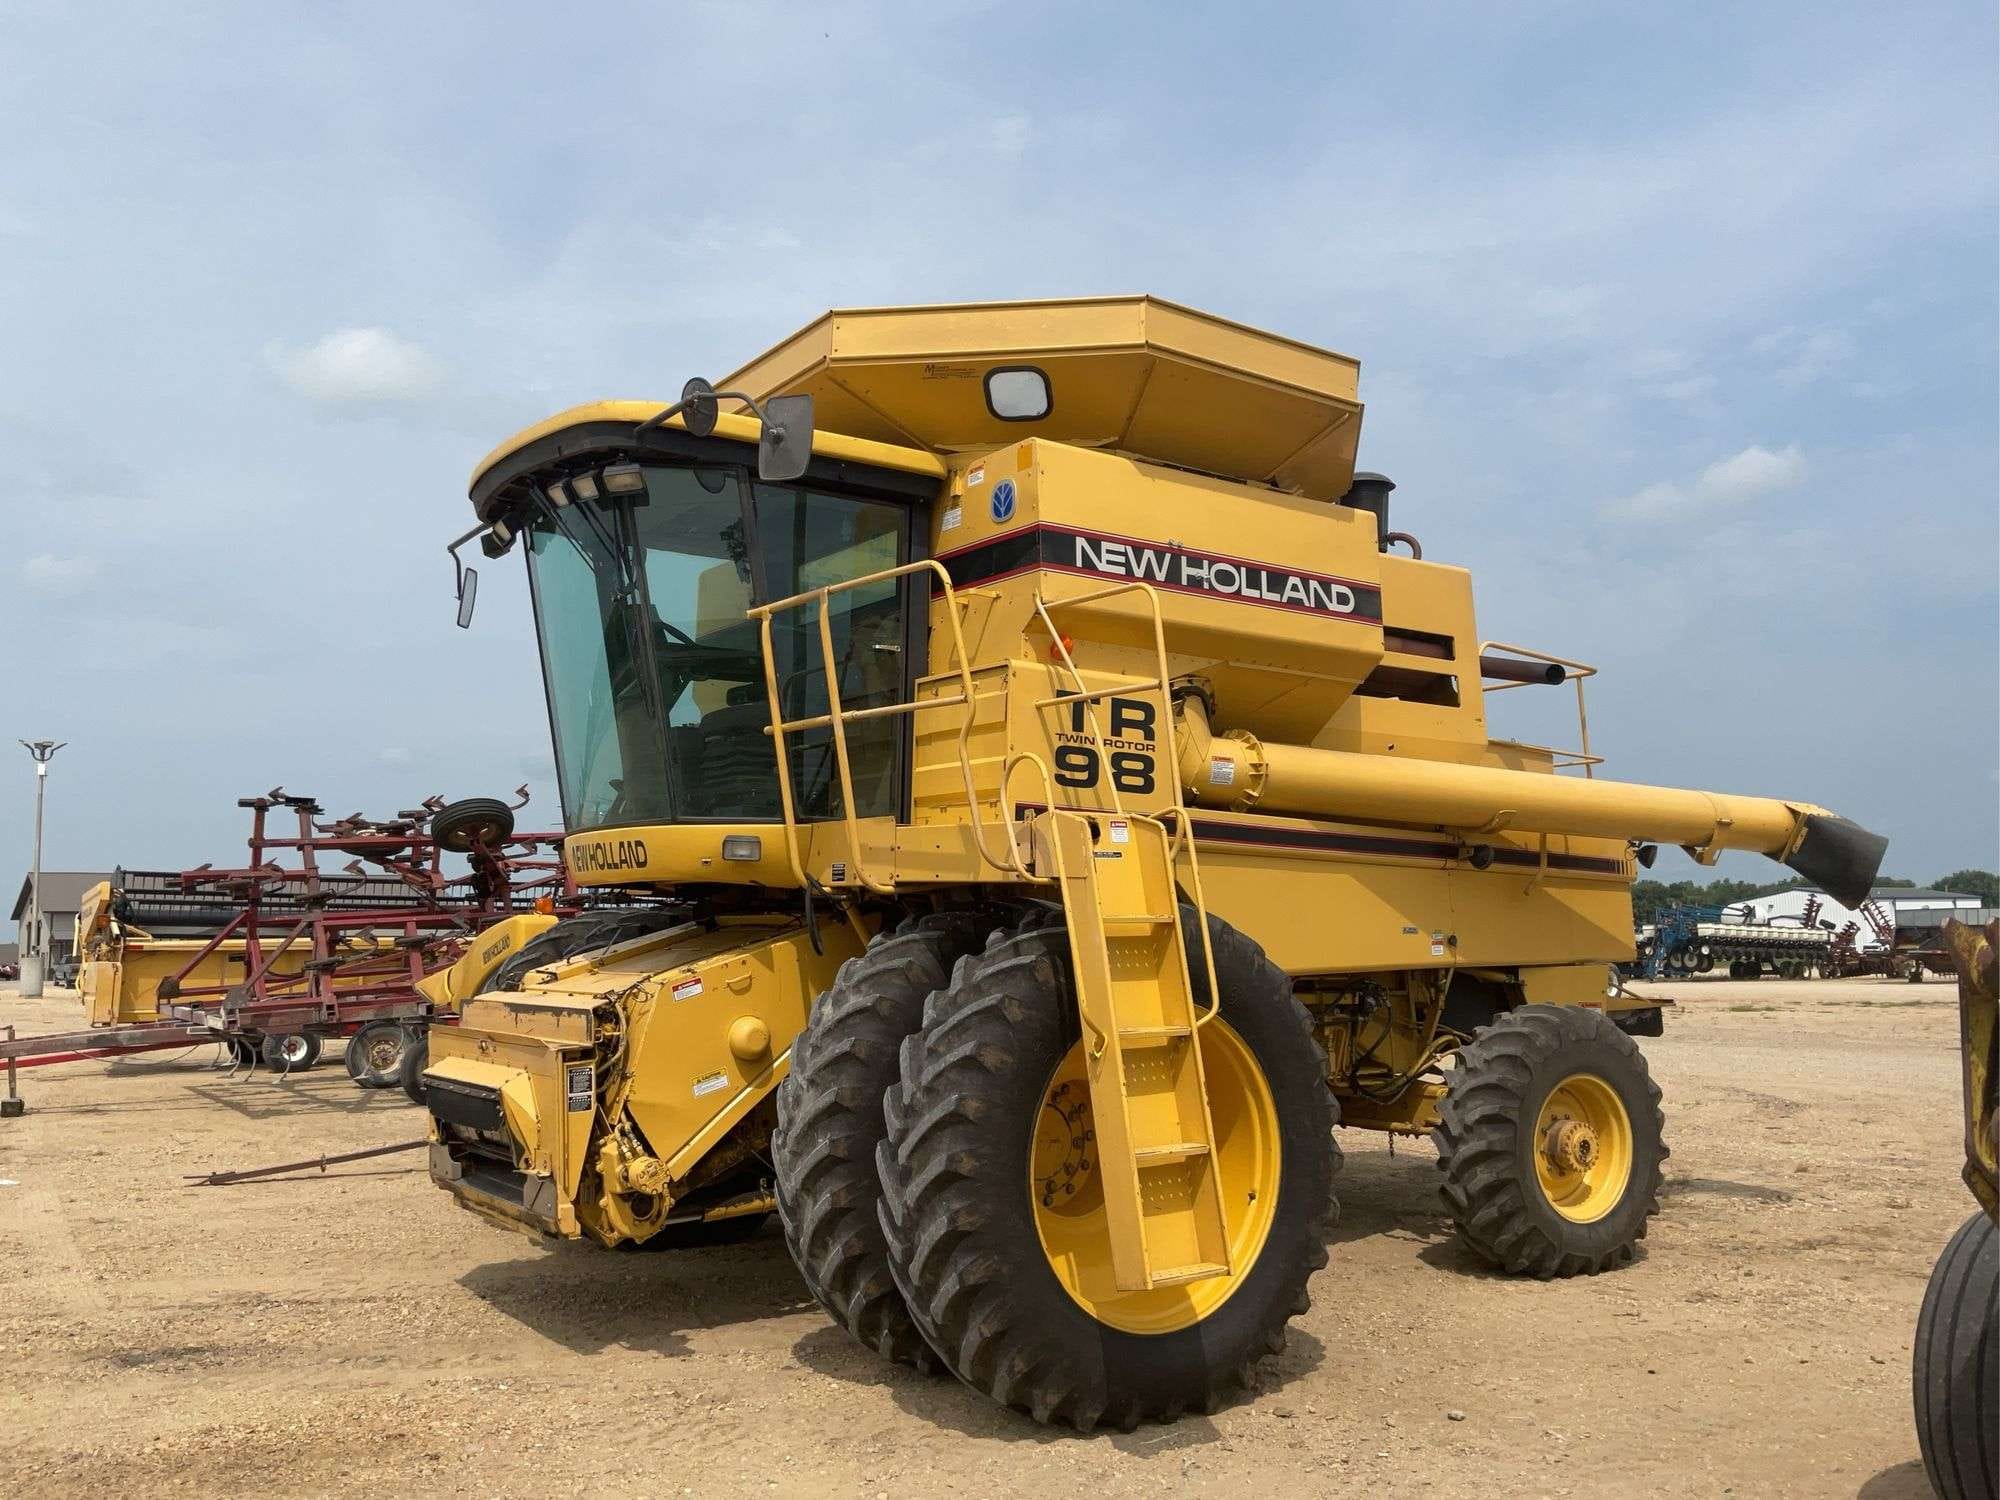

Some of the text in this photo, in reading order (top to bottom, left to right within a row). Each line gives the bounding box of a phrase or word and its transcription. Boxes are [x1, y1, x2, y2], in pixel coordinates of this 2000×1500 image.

[1075, 536, 1356, 614] NEW HOLLAND
[1056, 689, 1156, 742] TR
[1055, 732, 1156, 753] TWIN ROTOR
[1054, 745, 1156, 795] 98
[588, 840, 648, 871] HOLLAND
